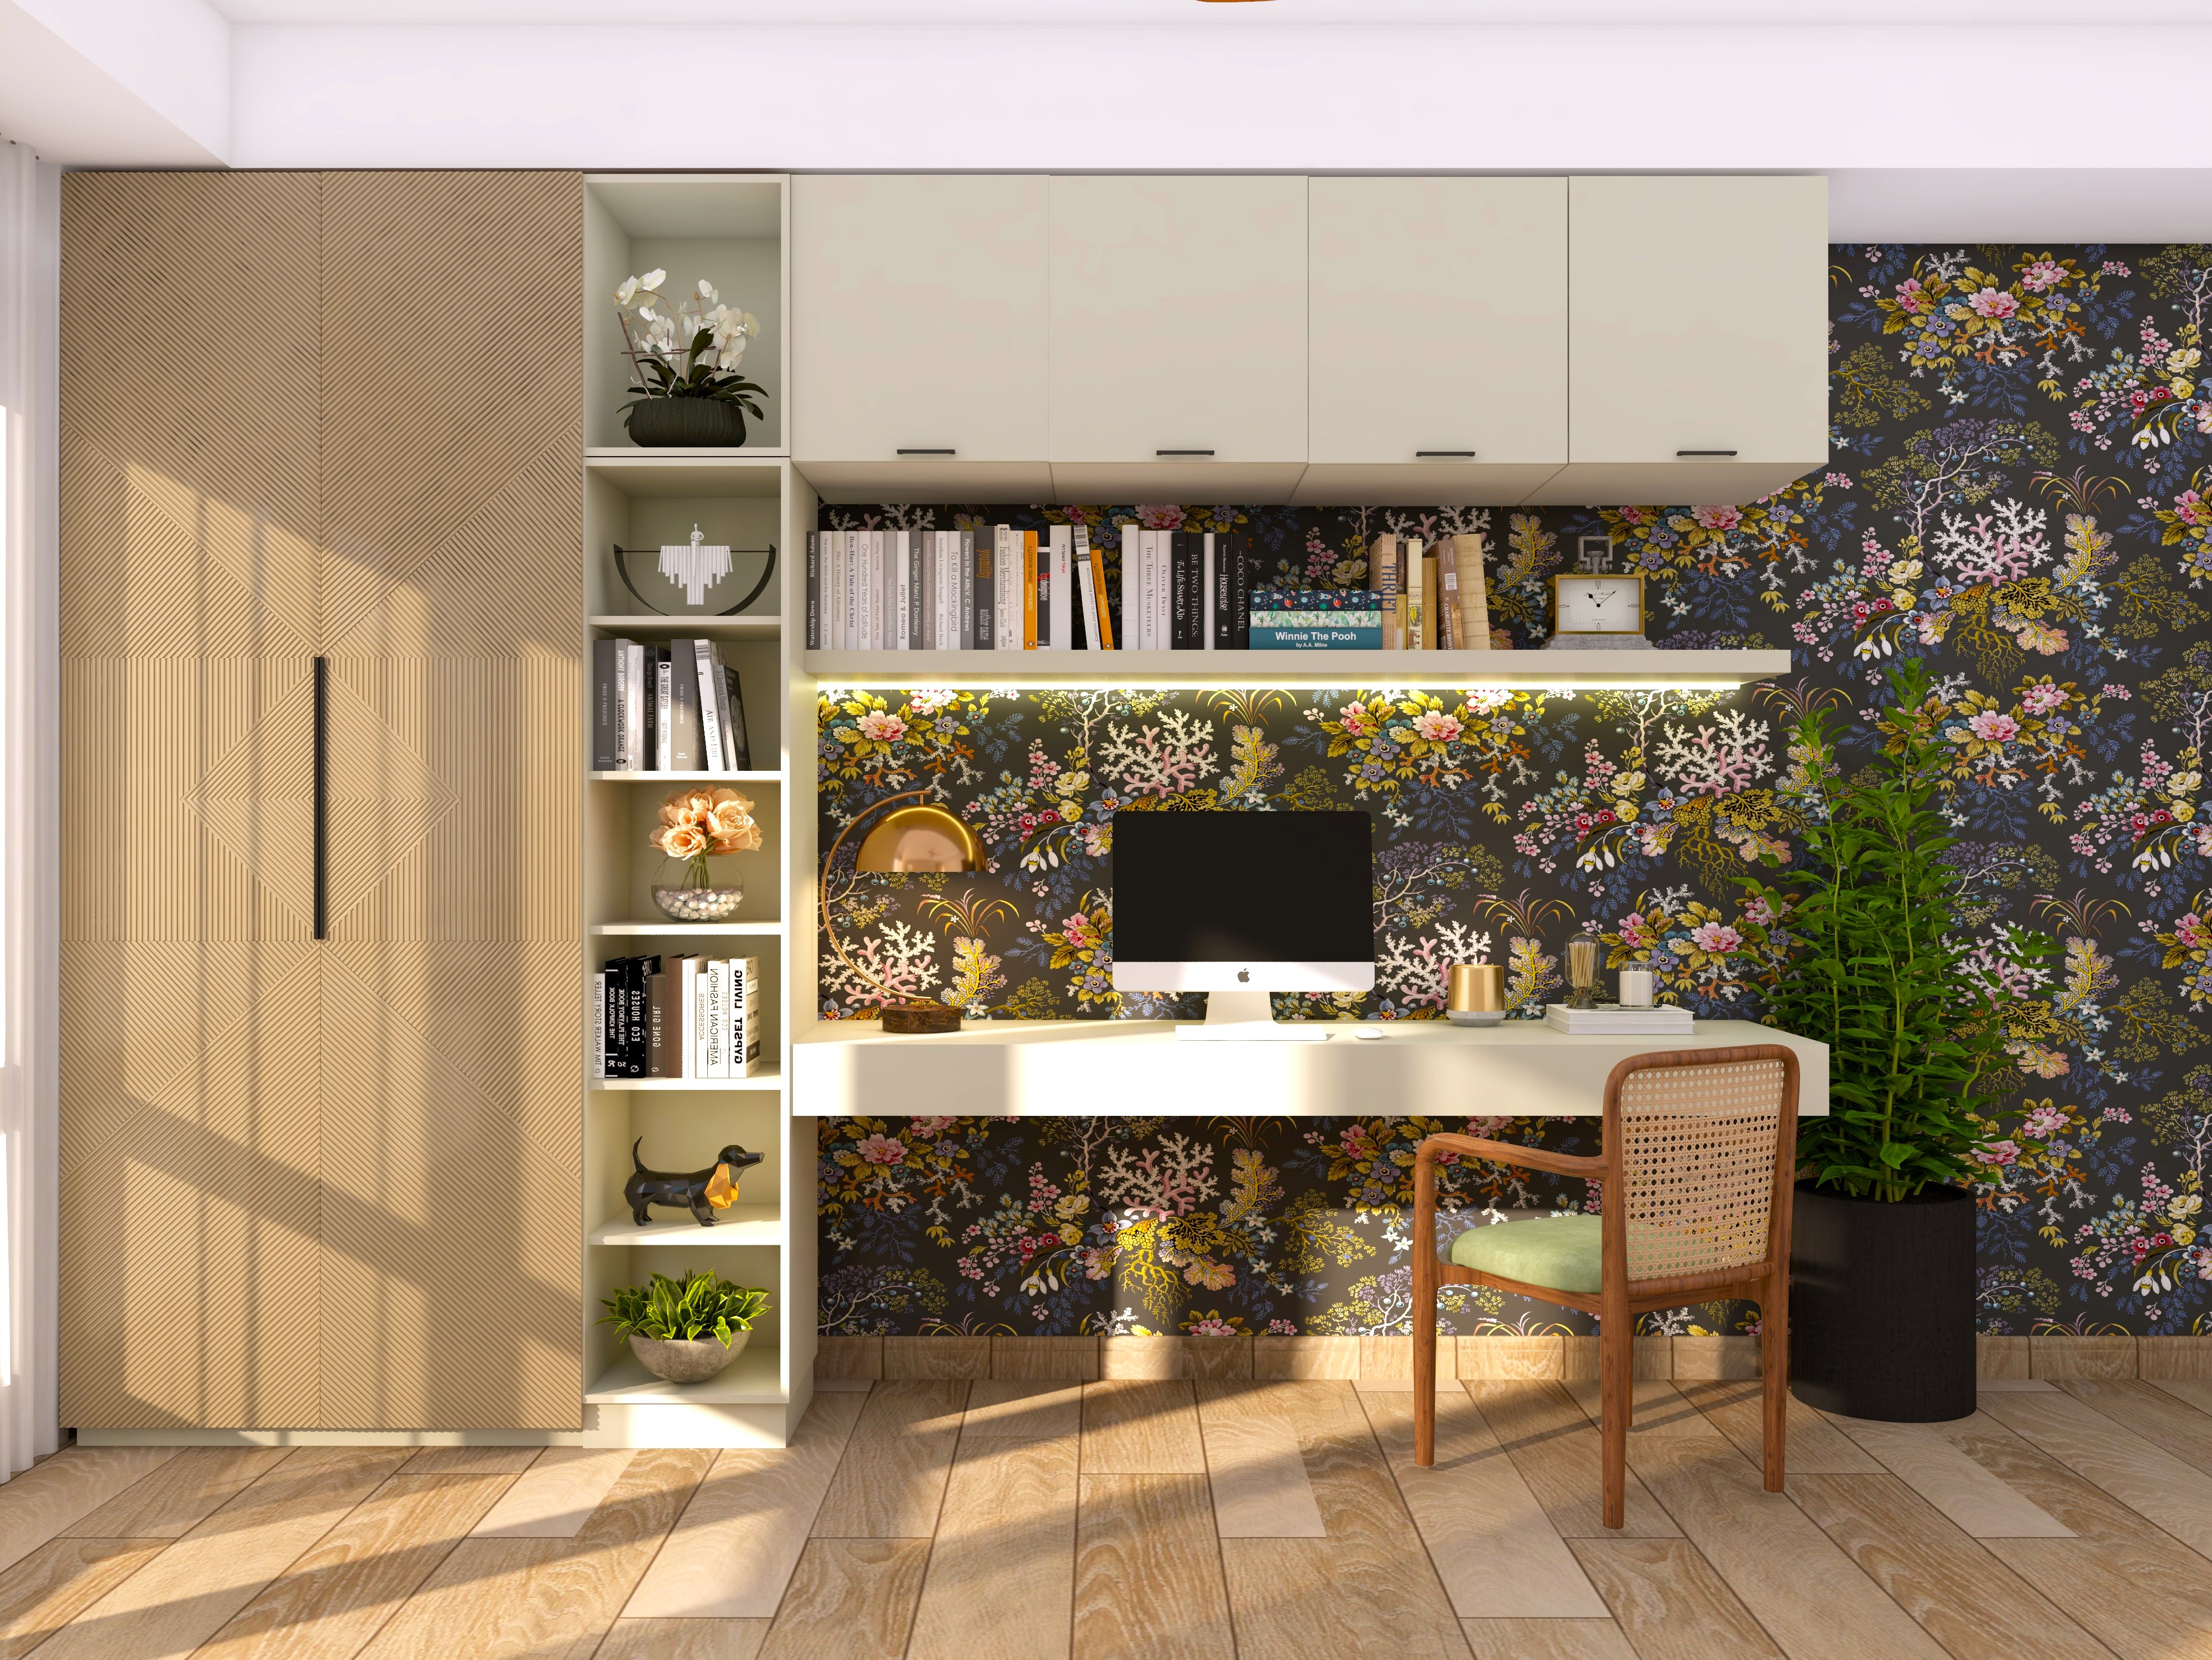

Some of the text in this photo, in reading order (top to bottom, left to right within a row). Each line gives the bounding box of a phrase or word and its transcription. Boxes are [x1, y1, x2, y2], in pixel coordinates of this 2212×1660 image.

[951, 551, 958, 560] To
[976, 549, 993, 579] youmility
[1192, 554, 1198, 565] BE
[998, 546, 1009, 605] Fashion Merchandising
[1382, 562, 1396, 614] THRIFT
[950, 582, 958, 631] Mockingbird
[998, 608, 1006, 618] James
[980, 609, 991, 640] author name
[1275, 631, 1357, 640] Winnie The Pooh
[660, 683, 669, 695] GREAT
[717, 674, 726, 695] Clockwork
[660, 696, 669, 709] GATSBY
